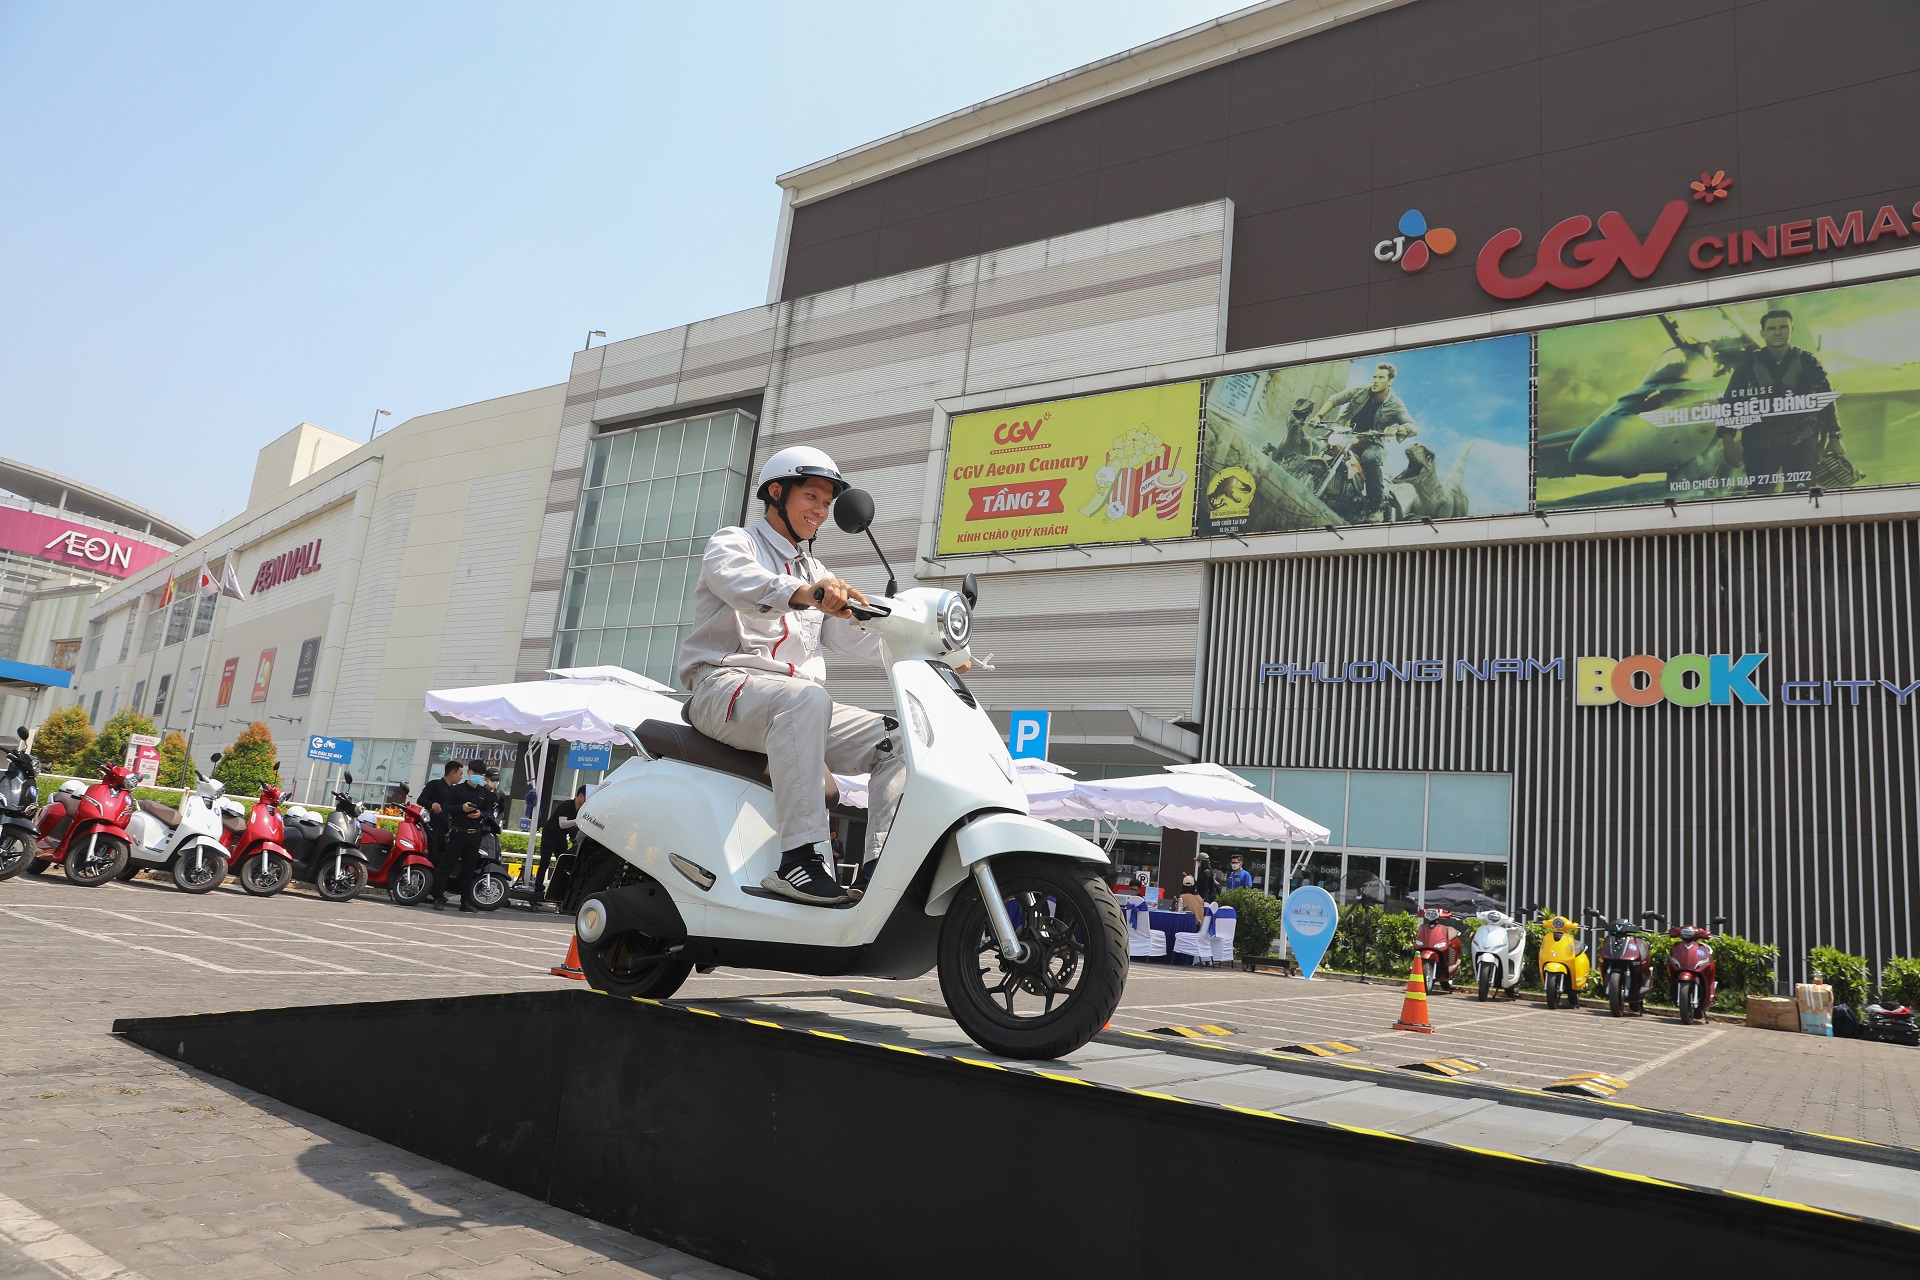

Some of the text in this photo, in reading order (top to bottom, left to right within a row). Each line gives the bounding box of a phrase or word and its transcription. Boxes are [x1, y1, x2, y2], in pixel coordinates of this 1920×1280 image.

[1374, 199, 1920, 299] CJ CGV CINEMA
[1731, 386, 1774, 398] CRUISE
[1665, 408, 1688, 423] PHI
[1691, 402, 1732, 420] CÔNG
[1733, 394, 1771, 417] SIÊU
[1715, 414, 1762, 427] MAVERICK
[994, 418, 1043, 445] CGV
[953, 455, 1089, 480] CGV Aeon Canary
[1670, 471, 1812, 491] KHỞI CHIẾU TẠI RẠP 27.05.2022
[982, 487, 1050, 513] TẦNG 2
[957, 524, 1069, 543] KÍNH CHÀO QUÝ KHÁCH
[282, 538, 322, 582] MALL
[1260, 653, 1920, 707] PHUONG NAM BOOK CITY
[1016, 720, 1040, 752] P
